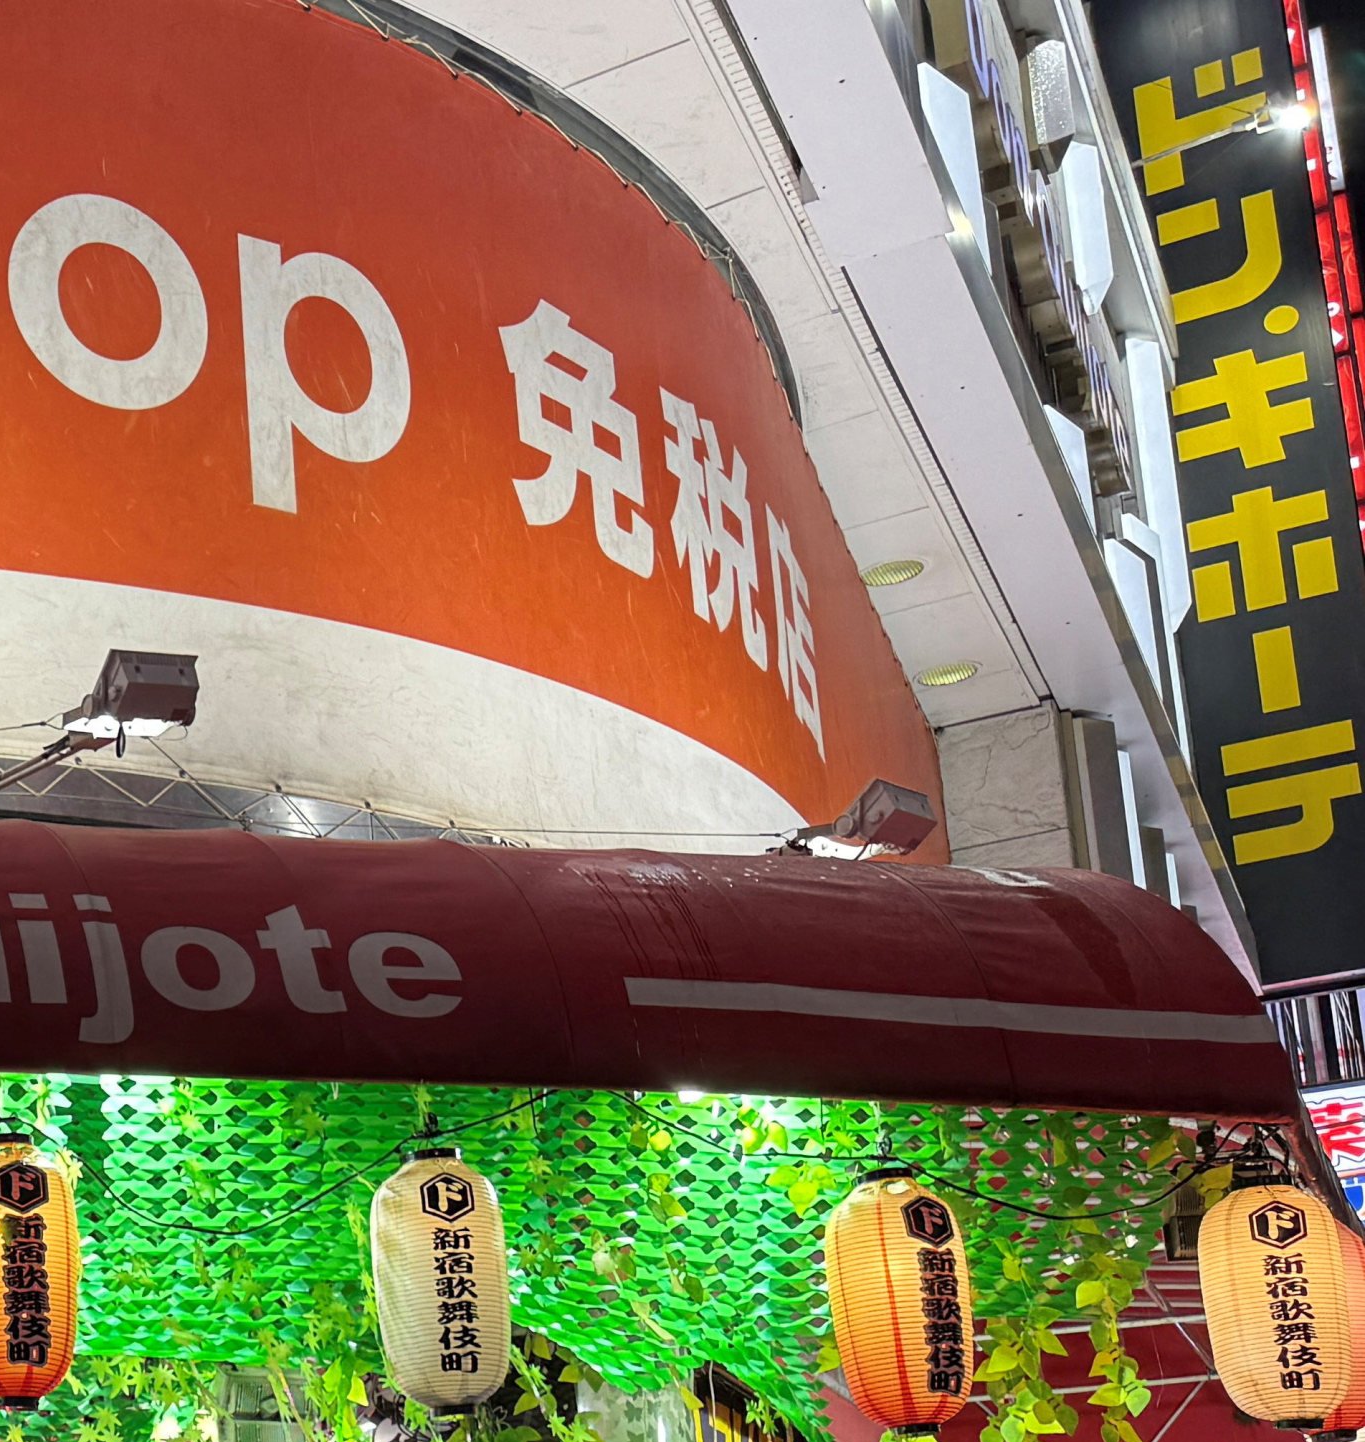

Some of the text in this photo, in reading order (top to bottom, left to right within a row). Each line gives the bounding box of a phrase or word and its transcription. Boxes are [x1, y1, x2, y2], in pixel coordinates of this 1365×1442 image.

[498, 299, 826, 764] 免税店
[1132, 47, 1362, 865] ドン・キホーテ
[1, 1213, 49, 1368] 新宿歌舞伎町
[433, 1226, 479, 1375] 新宿歌舞伎町
[918, 1248, 964, 1395] 新宿歌舞伎町
[1263, 1252, 1322, 1392] 新宿歌舞伎町
